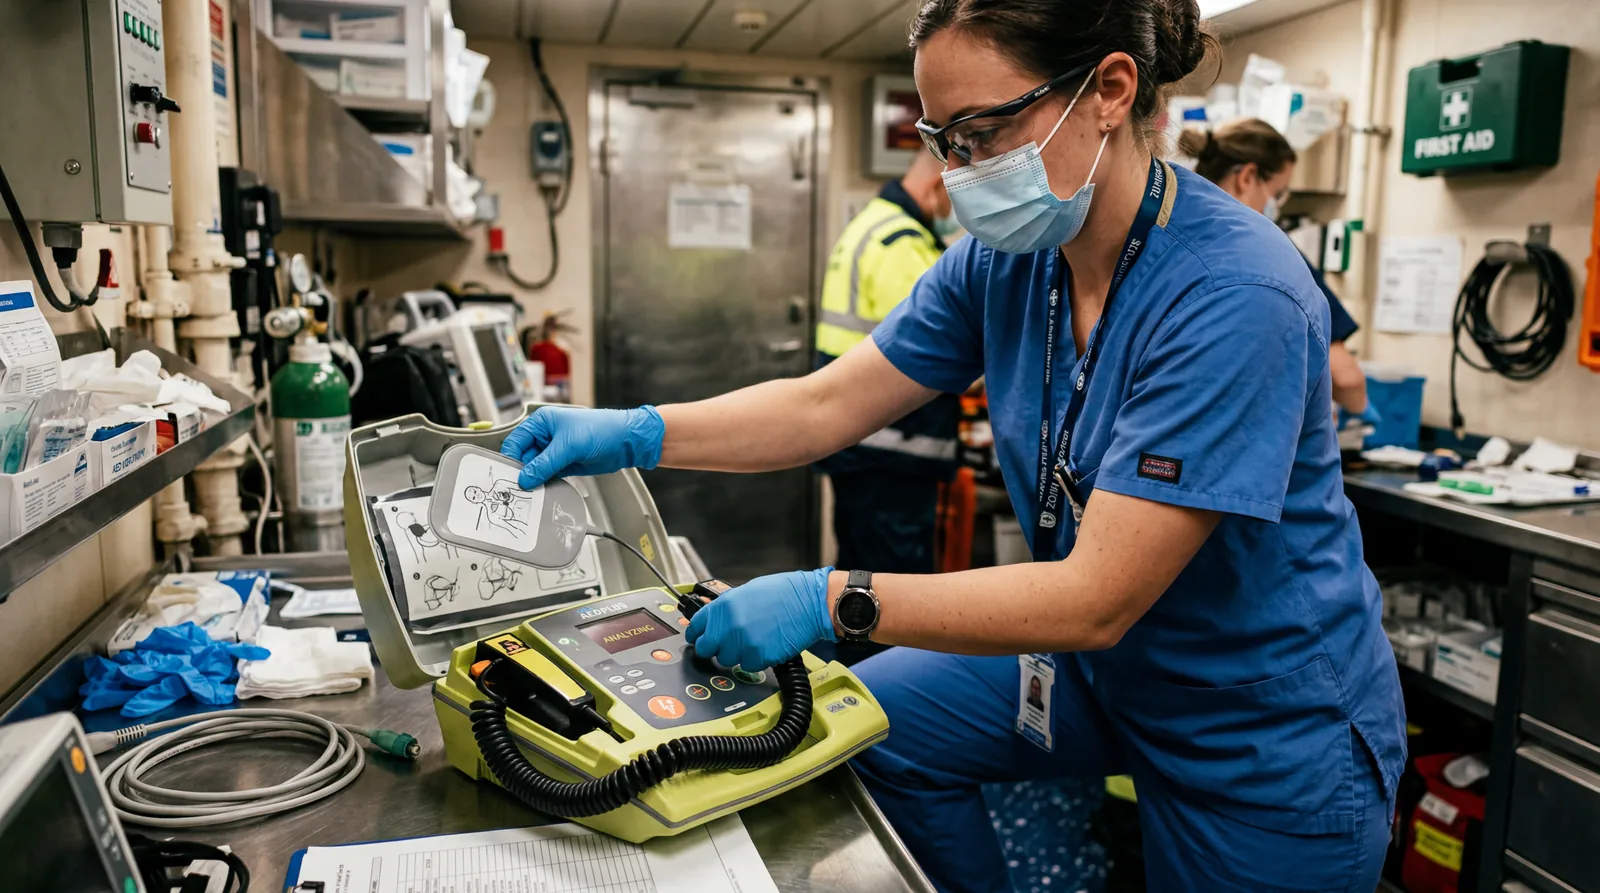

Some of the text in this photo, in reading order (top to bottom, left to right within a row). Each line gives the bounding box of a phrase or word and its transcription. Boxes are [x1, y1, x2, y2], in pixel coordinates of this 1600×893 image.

[1414, 129, 1495, 159] FIRST AID
[603, 625, 655, 643] ANALYZING
